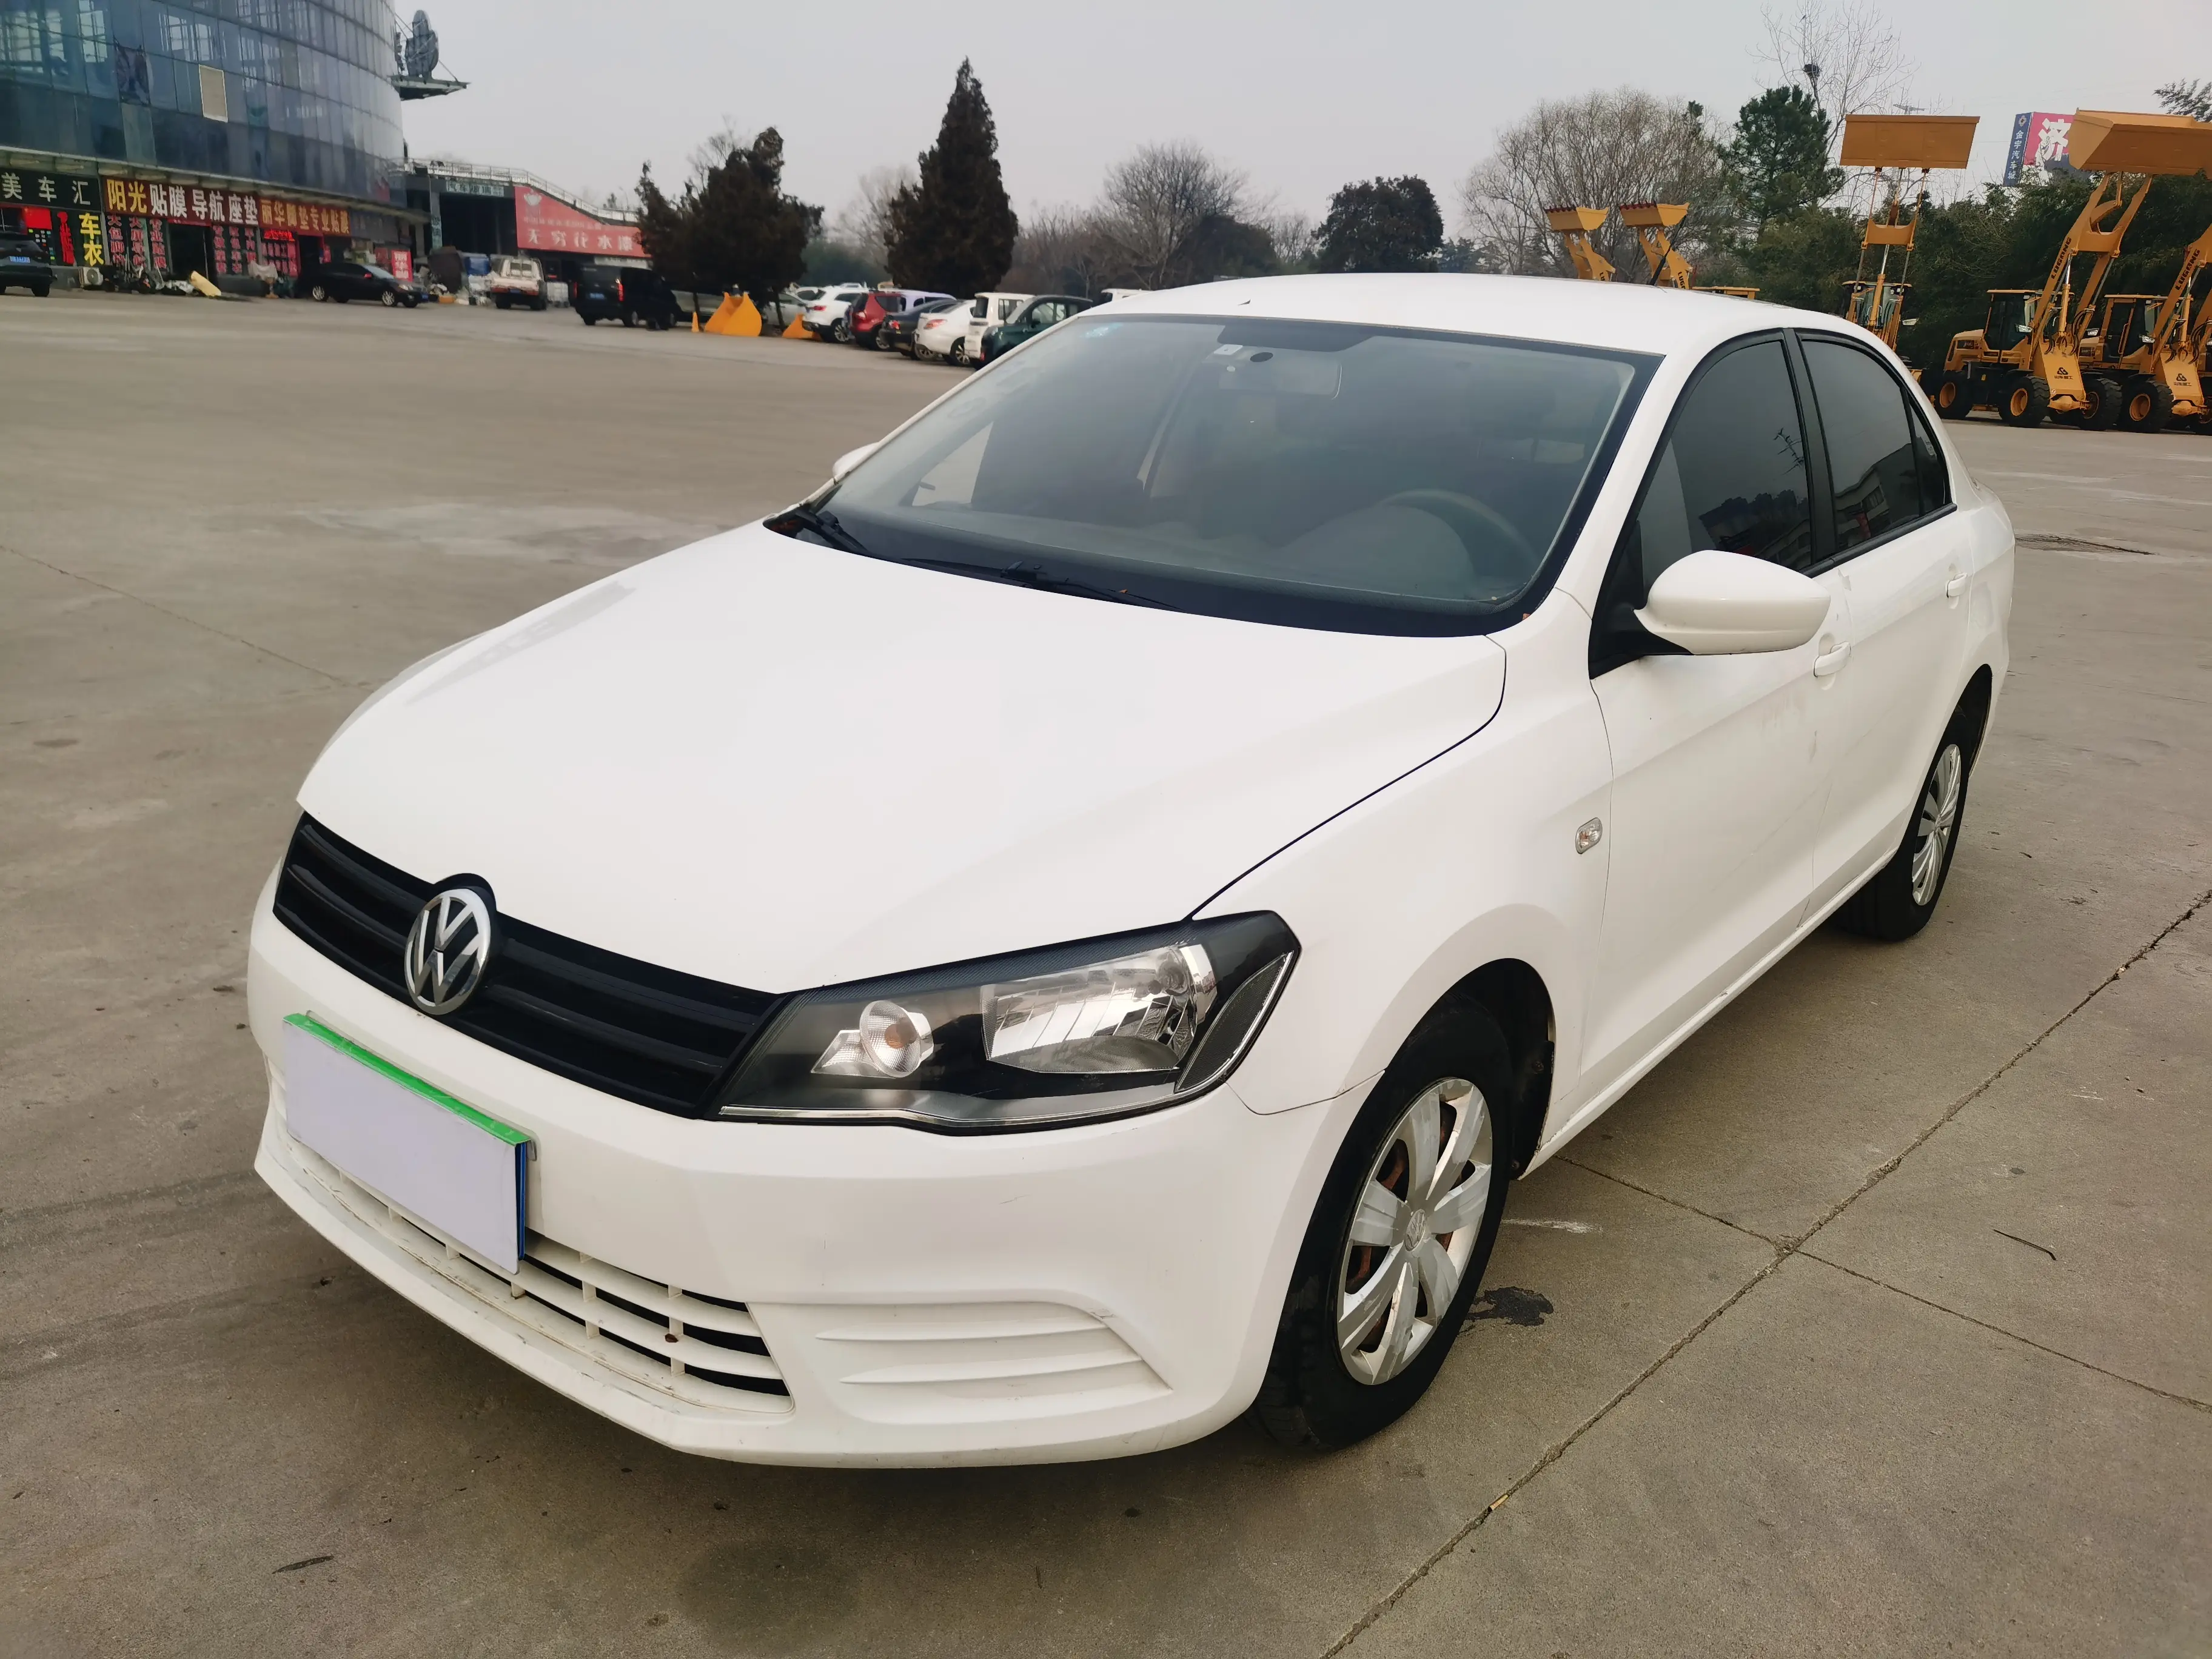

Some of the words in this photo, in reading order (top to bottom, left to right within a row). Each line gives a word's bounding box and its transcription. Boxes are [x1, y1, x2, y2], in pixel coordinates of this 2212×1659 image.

[2, 172, 90, 206] 美车汇
[106, 178, 259, 225] 阳光贴膜导航座垫
[79, 212, 104, 266] 车衣
